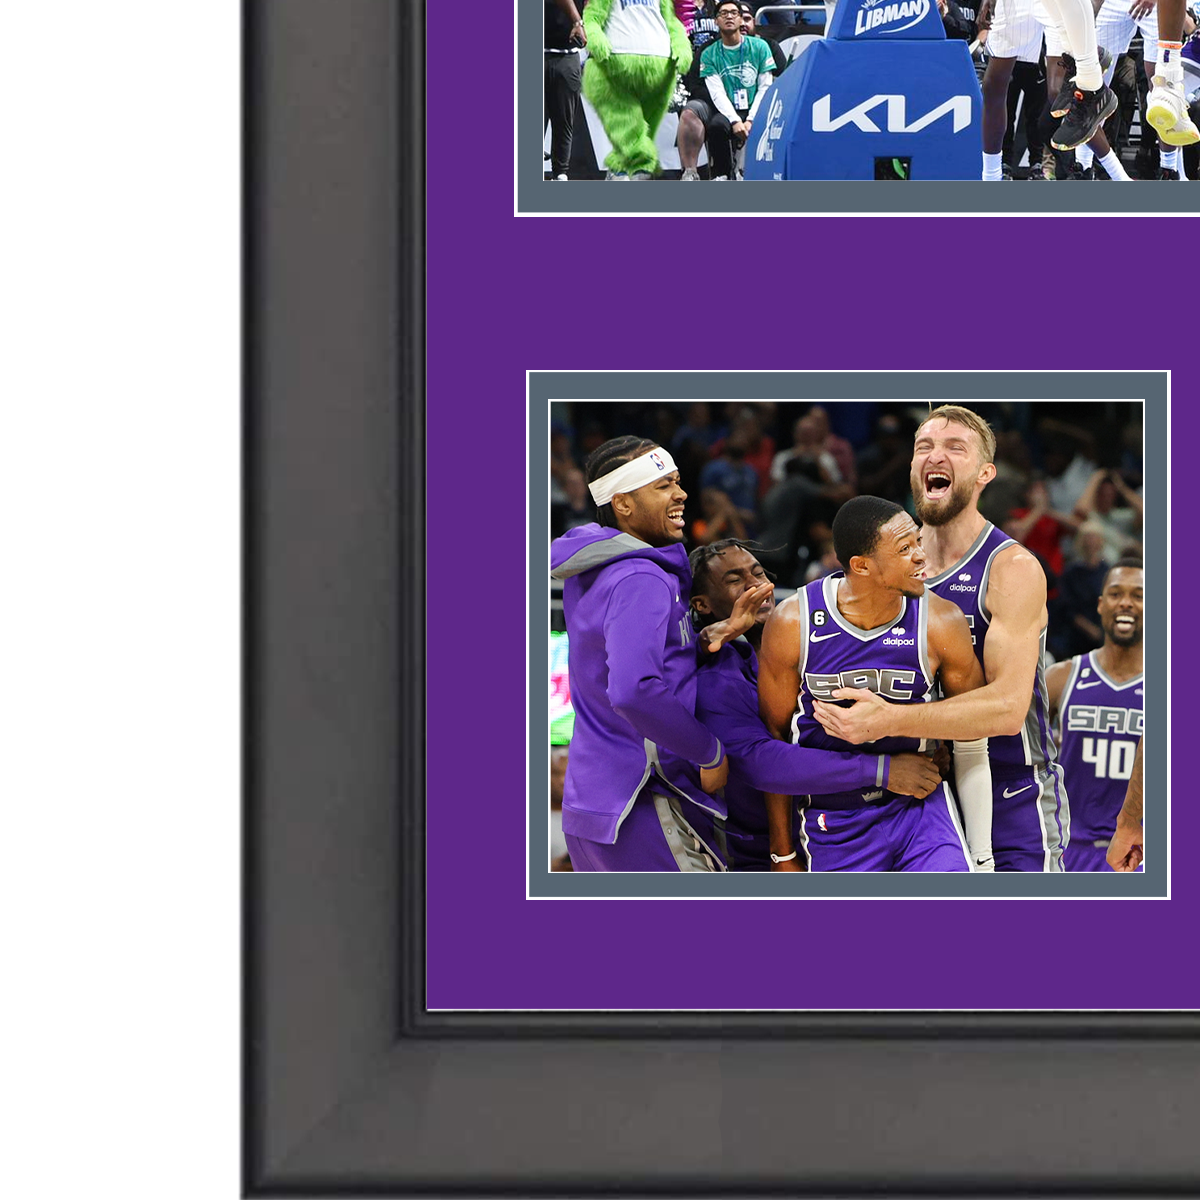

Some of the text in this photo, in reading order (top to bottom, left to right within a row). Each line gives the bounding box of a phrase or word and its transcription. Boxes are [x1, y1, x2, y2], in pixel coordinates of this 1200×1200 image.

[855, 0, 921, 35] LIBMAN
[950, 584, 977, 593] dialpad
[814, 611, 825, 626] 6
[883, 637, 914, 647] dialpad
[805, 669, 916, 702] SAC
[1082, 738, 1137, 780] 40
